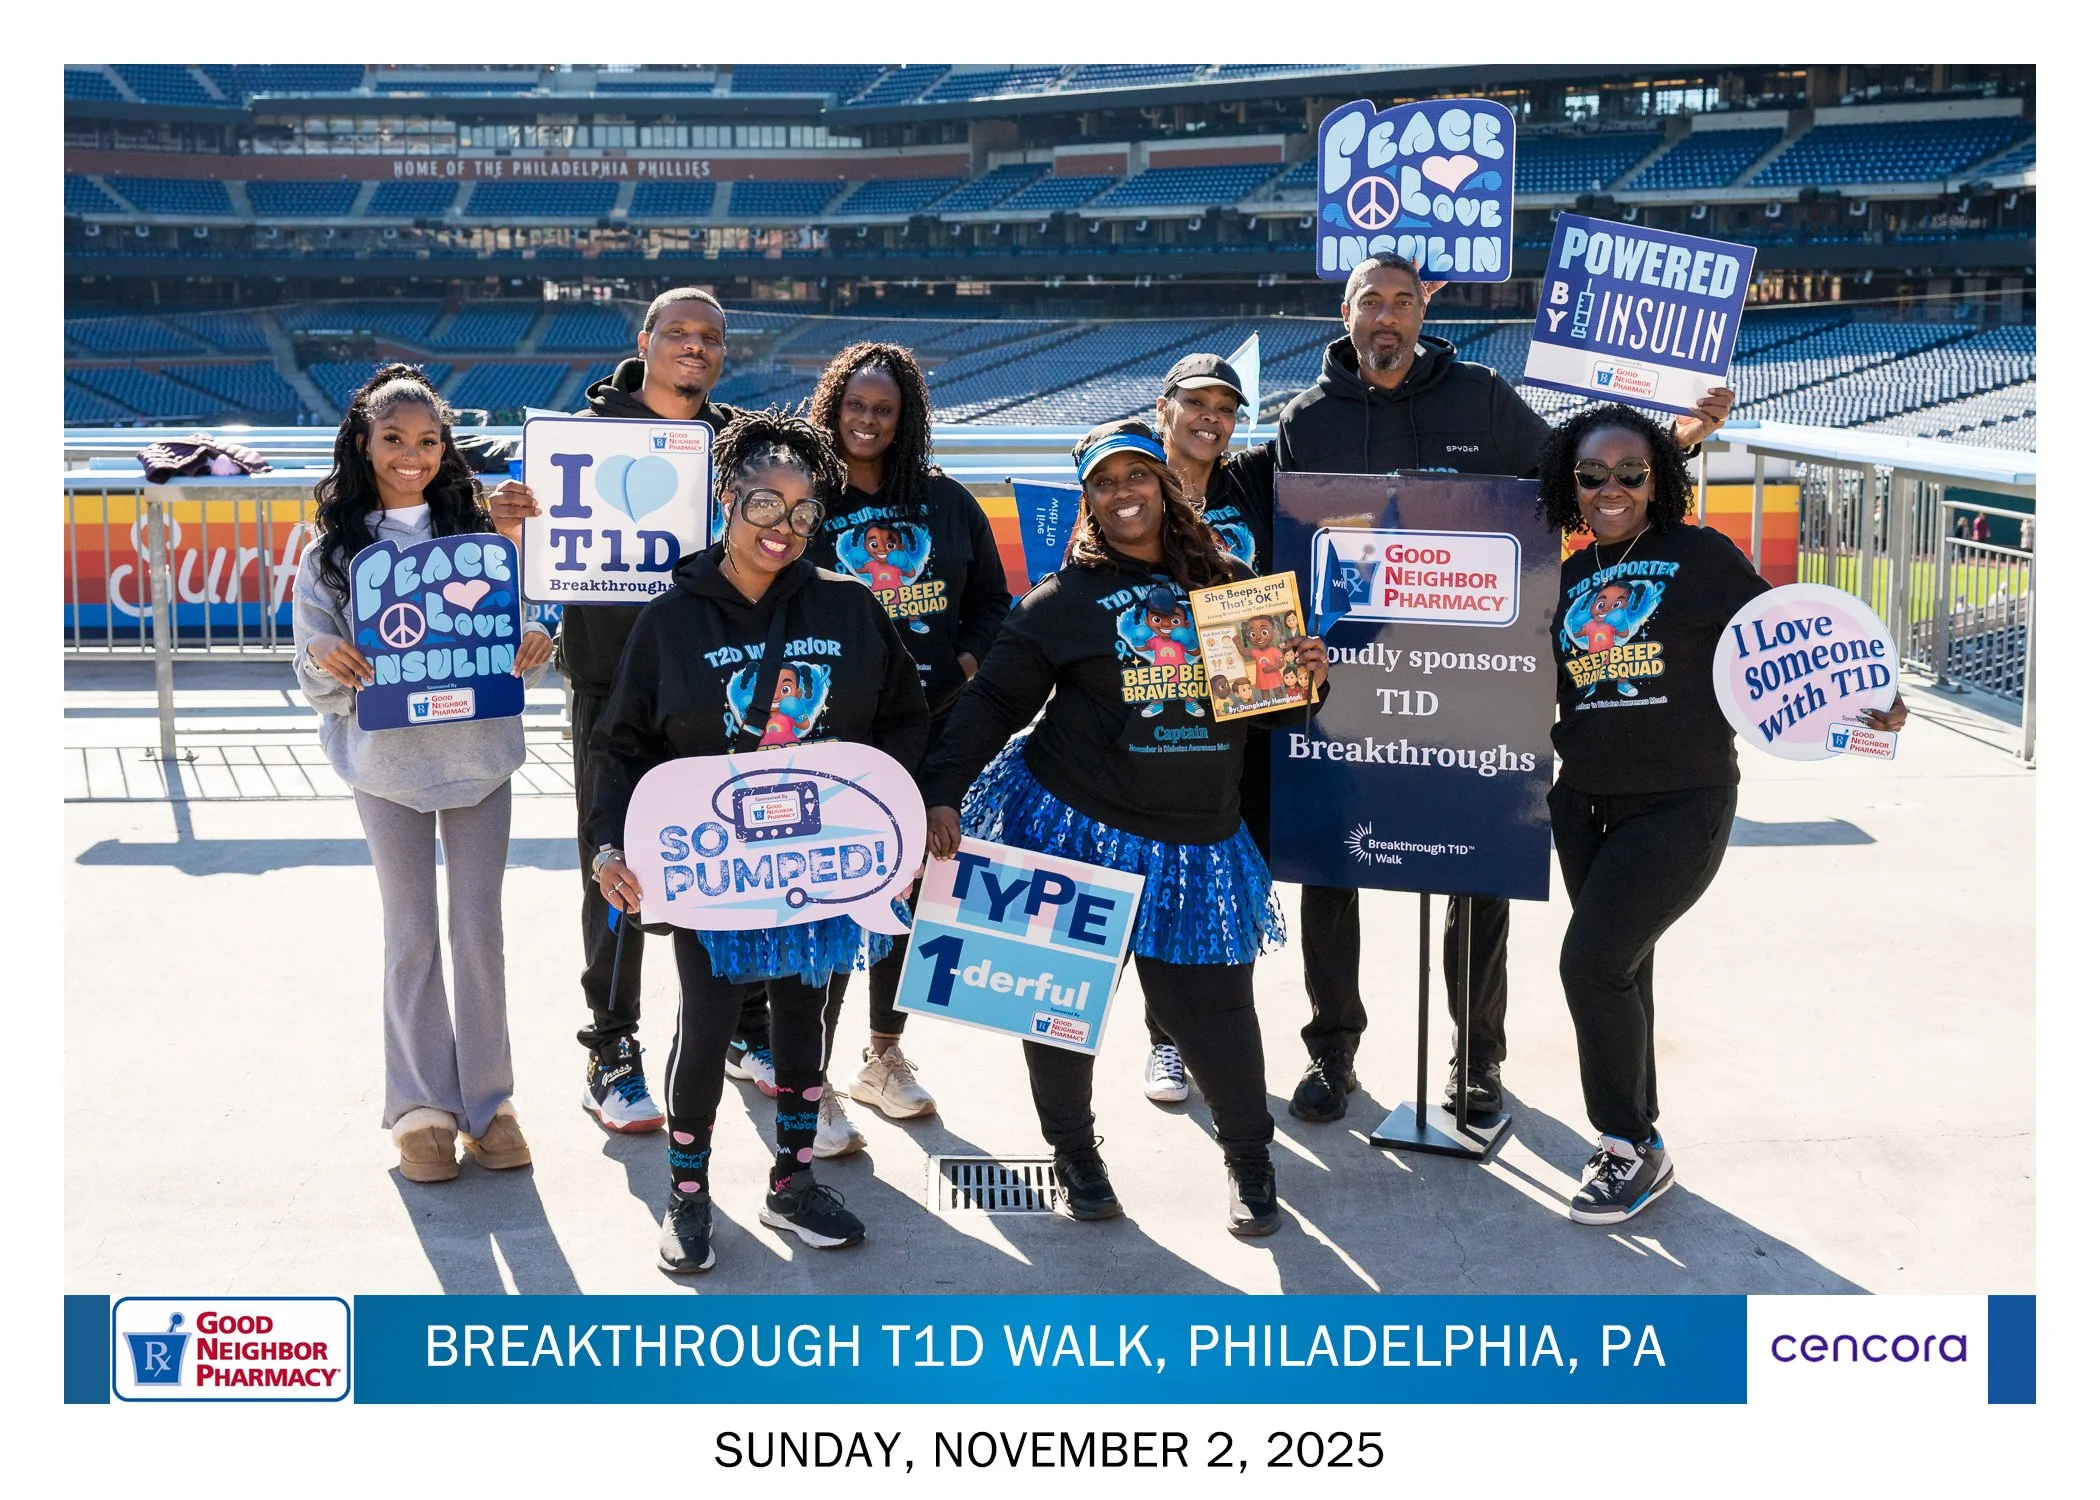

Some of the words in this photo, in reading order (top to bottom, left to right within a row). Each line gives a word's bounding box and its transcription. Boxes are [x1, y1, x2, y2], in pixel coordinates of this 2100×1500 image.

[1324, 108, 1505, 195] PEACE
[393, 160, 439, 177] HOME
[446, 160, 466, 176] OF
[475, 161, 503, 176] THE
[512, 161, 629, 177] PHILADELPHIA
[638, 162, 711, 177] PHILLIES
[1401, 165, 1502, 228] LOVE
[1559, 226, 1740, 299] POWERED
[1594, 291, 1728, 364] INSULIN
[1446, 445, 1479, 453] SPYDER
[550, 453, 594, 519] I
[550, 528, 680, 573] T1D
[1385, 544, 1451, 565] GOOD
[356, 542, 511, 622] PEACE
[550, 579, 677, 595] Breakthroughs
[898, 580, 945, 603] BEEP
[1205, 592, 1224, 603] She
[1227, 586, 1262, 599] Beeps,
[1265, 579, 1285, 591] and
[1385, 566, 1498, 589] NEIGHBOR
[1567, 578, 1591, 599] T1D
[1592, 560, 1680, 586] SUPPORTER
[425, 592, 513, 638] LOVE
[898, 596, 948, 617] SQUAD
[1096, 589, 1133, 611] T1D
[1220, 597, 1253, 611] That's
[1255, 594, 1272, 604] OK
[704, 646, 744, 668] T2D
[744, 637, 842, 660] WRRIOR
[1731, 623, 1750, 659] I
[1752, 615, 1833, 652] Love
[1326, 643, 1403, 673] oudly
[1409, 650, 1537, 674] sponsors
[1566, 650, 1609, 675] BEEP
[1610, 642, 1663, 663] BEEP
[1608, 660, 1664, 679] SQUAD
[1745, 638, 1885, 701] someone
[1122, 665, 1176, 687] BEEP
[1179, 664, 1207, 681] BE
[1122, 682, 1177, 702] BRAVE
[1178, 680, 1210, 699] SQU
[1377, 688, 1439, 716] T1D
[1758, 682, 1827, 743] with
[1831, 663, 1891, 699] T1D
[1154, 725, 1209, 743] Captain
[1163, 744, 1188, 752] Diabetes
[1289, 733, 1536, 777] Breakthroughs
[659, 821, 729, 862] SO
[1368, 839, 1446, 856] Breakthrough
[663, 840, 888, 901] PUMPED!
[1375, 853, 1402, 865] Walk
[952, 851, 1116, 946] TYPE
